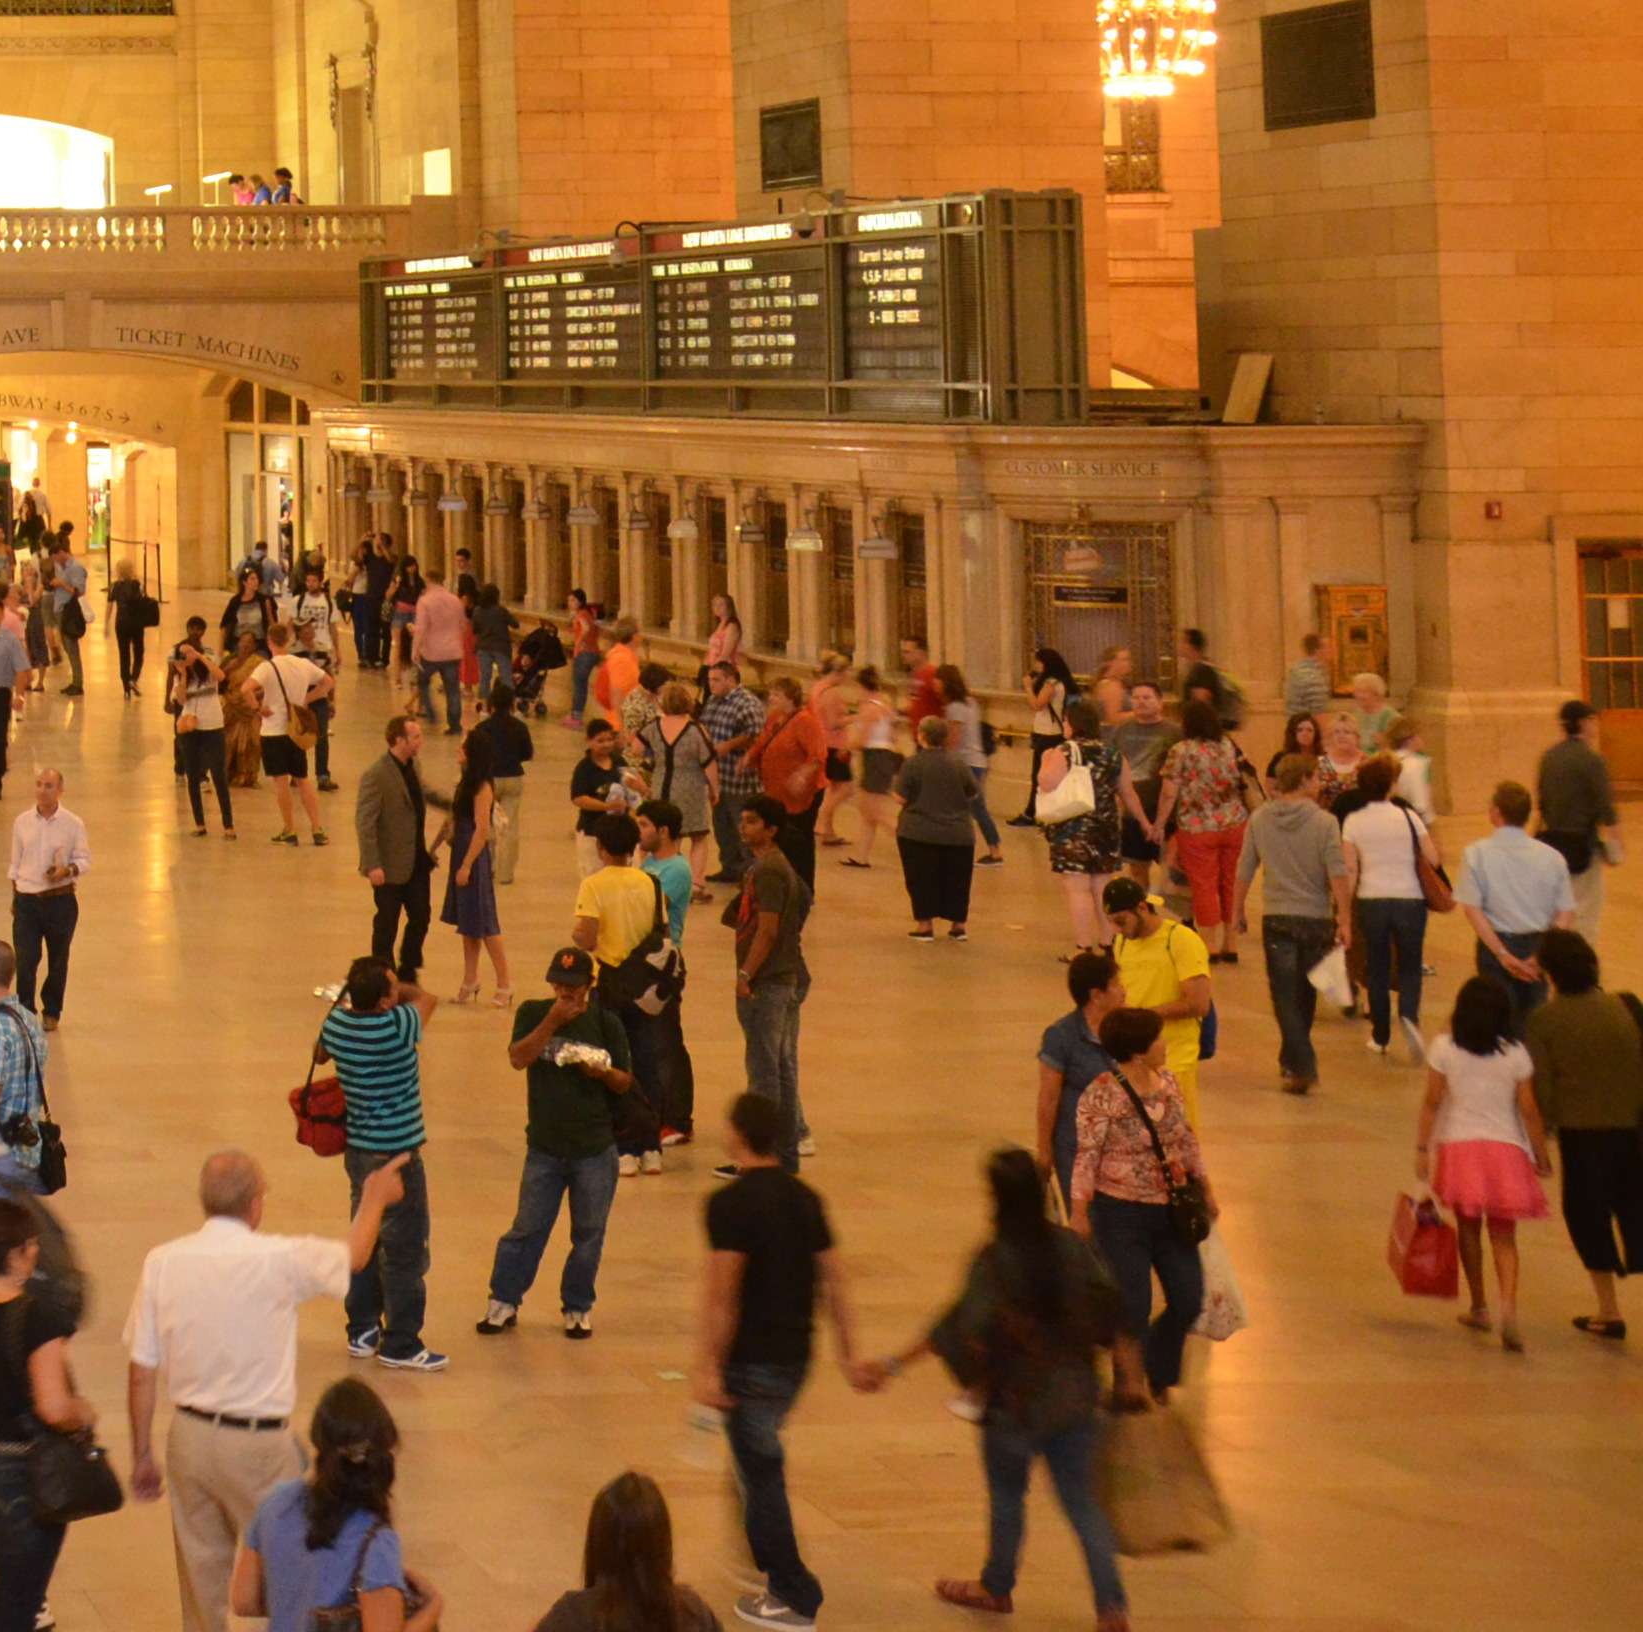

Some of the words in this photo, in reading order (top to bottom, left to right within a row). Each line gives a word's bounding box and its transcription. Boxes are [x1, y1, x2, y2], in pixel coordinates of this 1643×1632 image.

[857, 211, 923, 232] INFORMATION
[1, 327, 40, 344] AVE
[115, 327, 187, 348] TICKET
[195, 335, 301, 371] MACHINES
[53, 400, 61, 412] 4
[66, 402, 74, 414] 5
[79, 404, 88, 416] 6
[93, 406, 101, 419] 7
[106, 409, 114, 422] S
[1003, 462, 1085, 475] CUSTOMER
[1091, 463, 1161, 476] SERVICE
